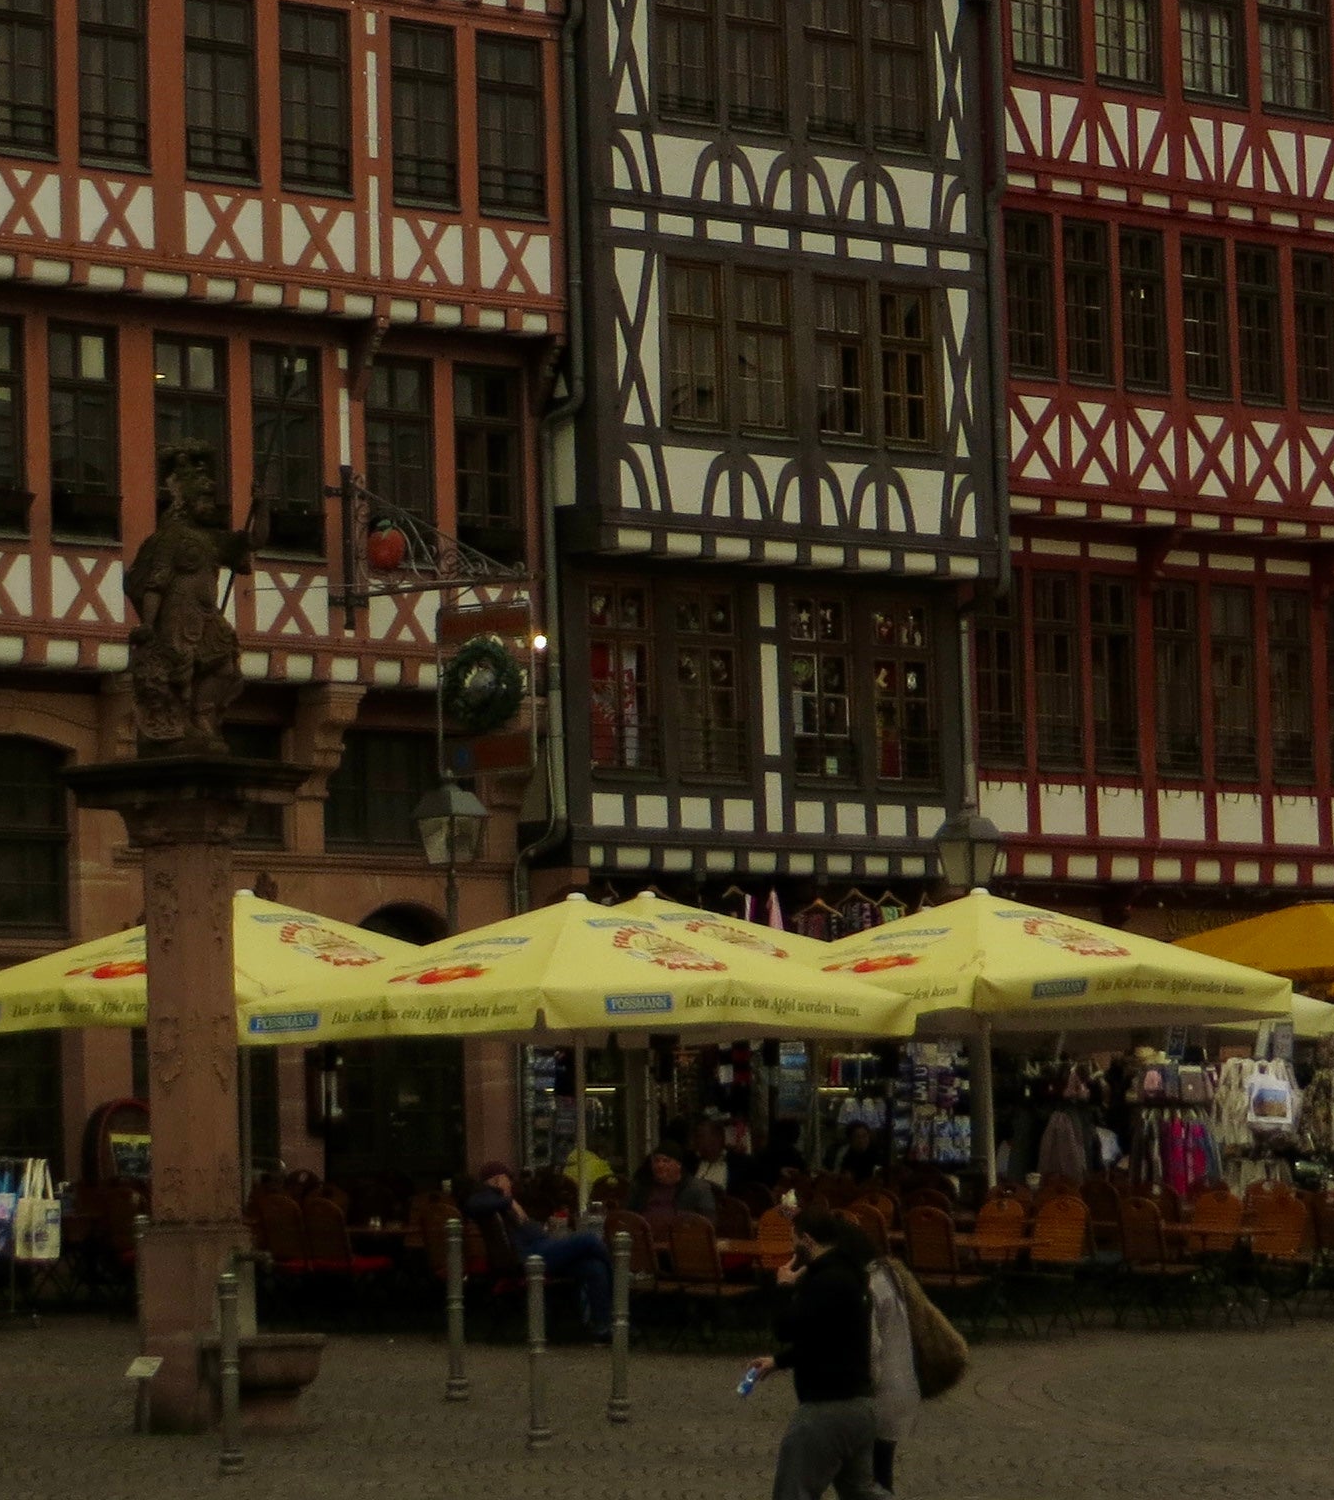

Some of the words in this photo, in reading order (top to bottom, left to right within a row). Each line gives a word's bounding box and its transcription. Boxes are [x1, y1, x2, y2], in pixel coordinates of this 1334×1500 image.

[331, 1010, 351, 1025] Das
[421, 1004, 450, 1023] Apfel
[451, 1003, 490, 1019] werden
